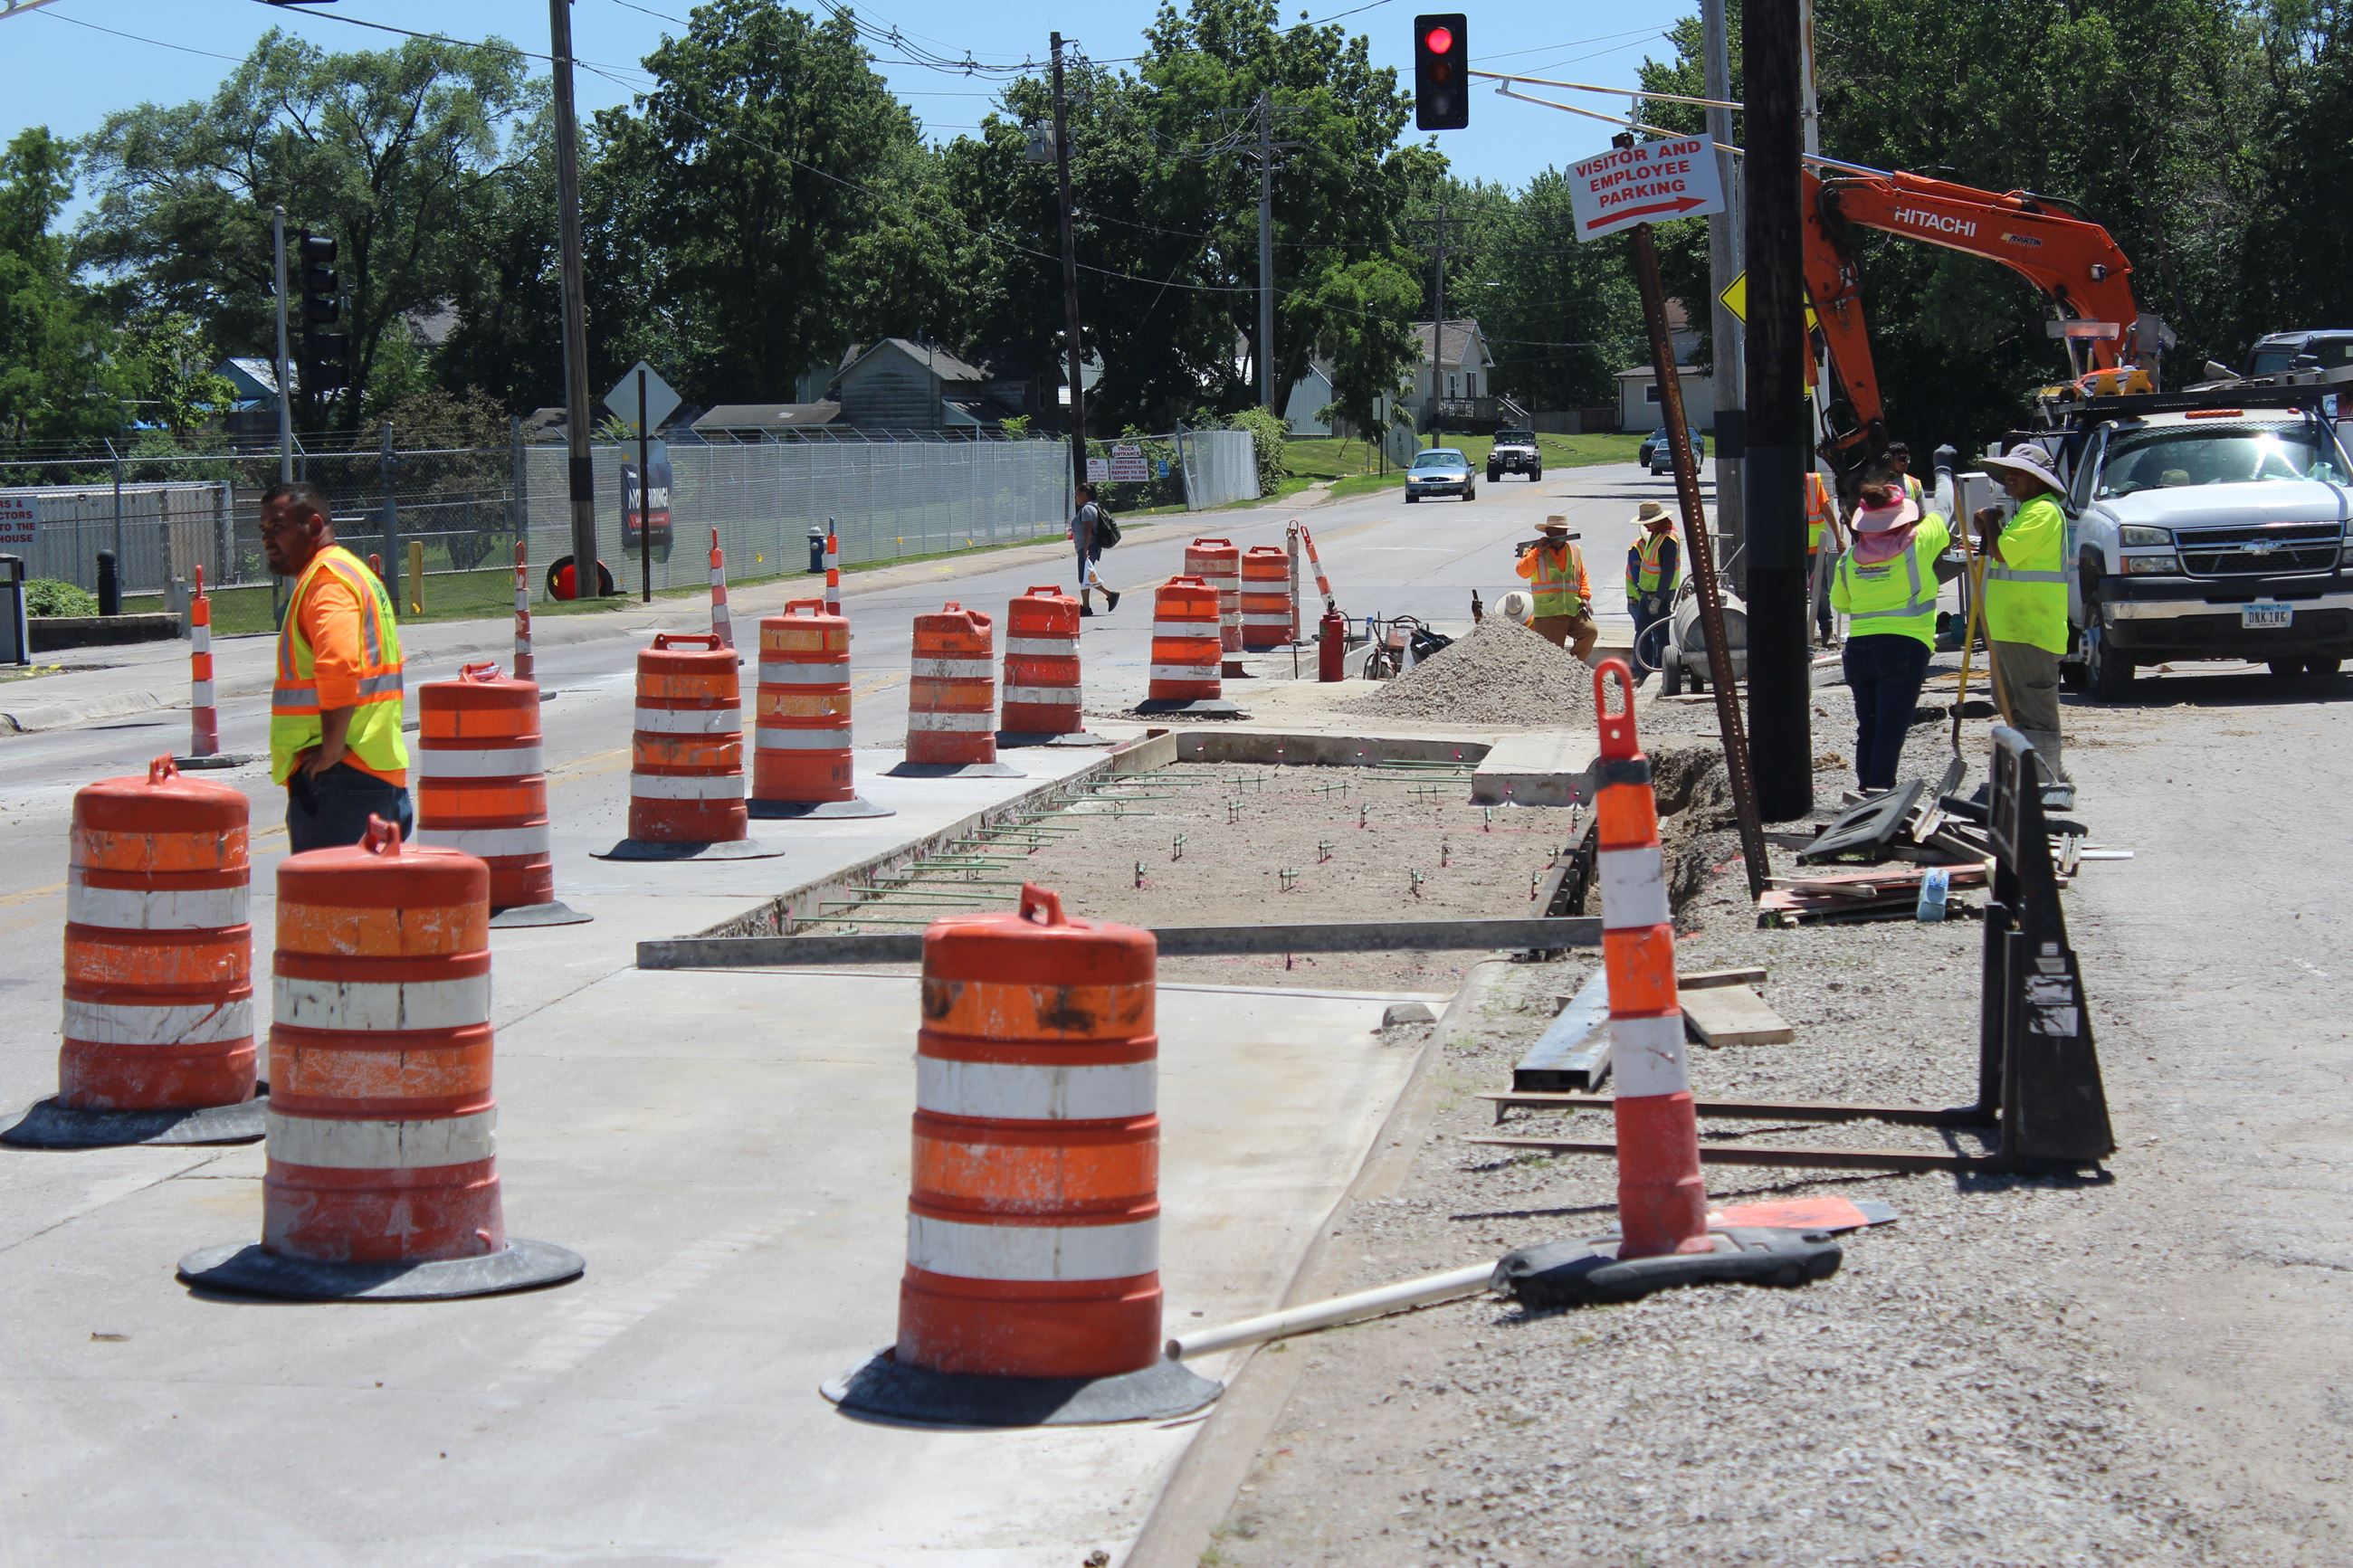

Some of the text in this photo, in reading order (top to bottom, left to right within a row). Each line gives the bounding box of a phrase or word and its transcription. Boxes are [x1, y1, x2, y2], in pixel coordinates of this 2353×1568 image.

[1576, 140, 1701, 178] VISITOR AND
[1589, 159, 1691, 193] EMPLOYEE
[1599, 179, 1686, 208] PARKING
[1893, 206, 1977, 237] HITACHI
[16, 499, 24, 508] &
[628, 488, 642, 509] NO
[15, 522, 36, 531] THE
